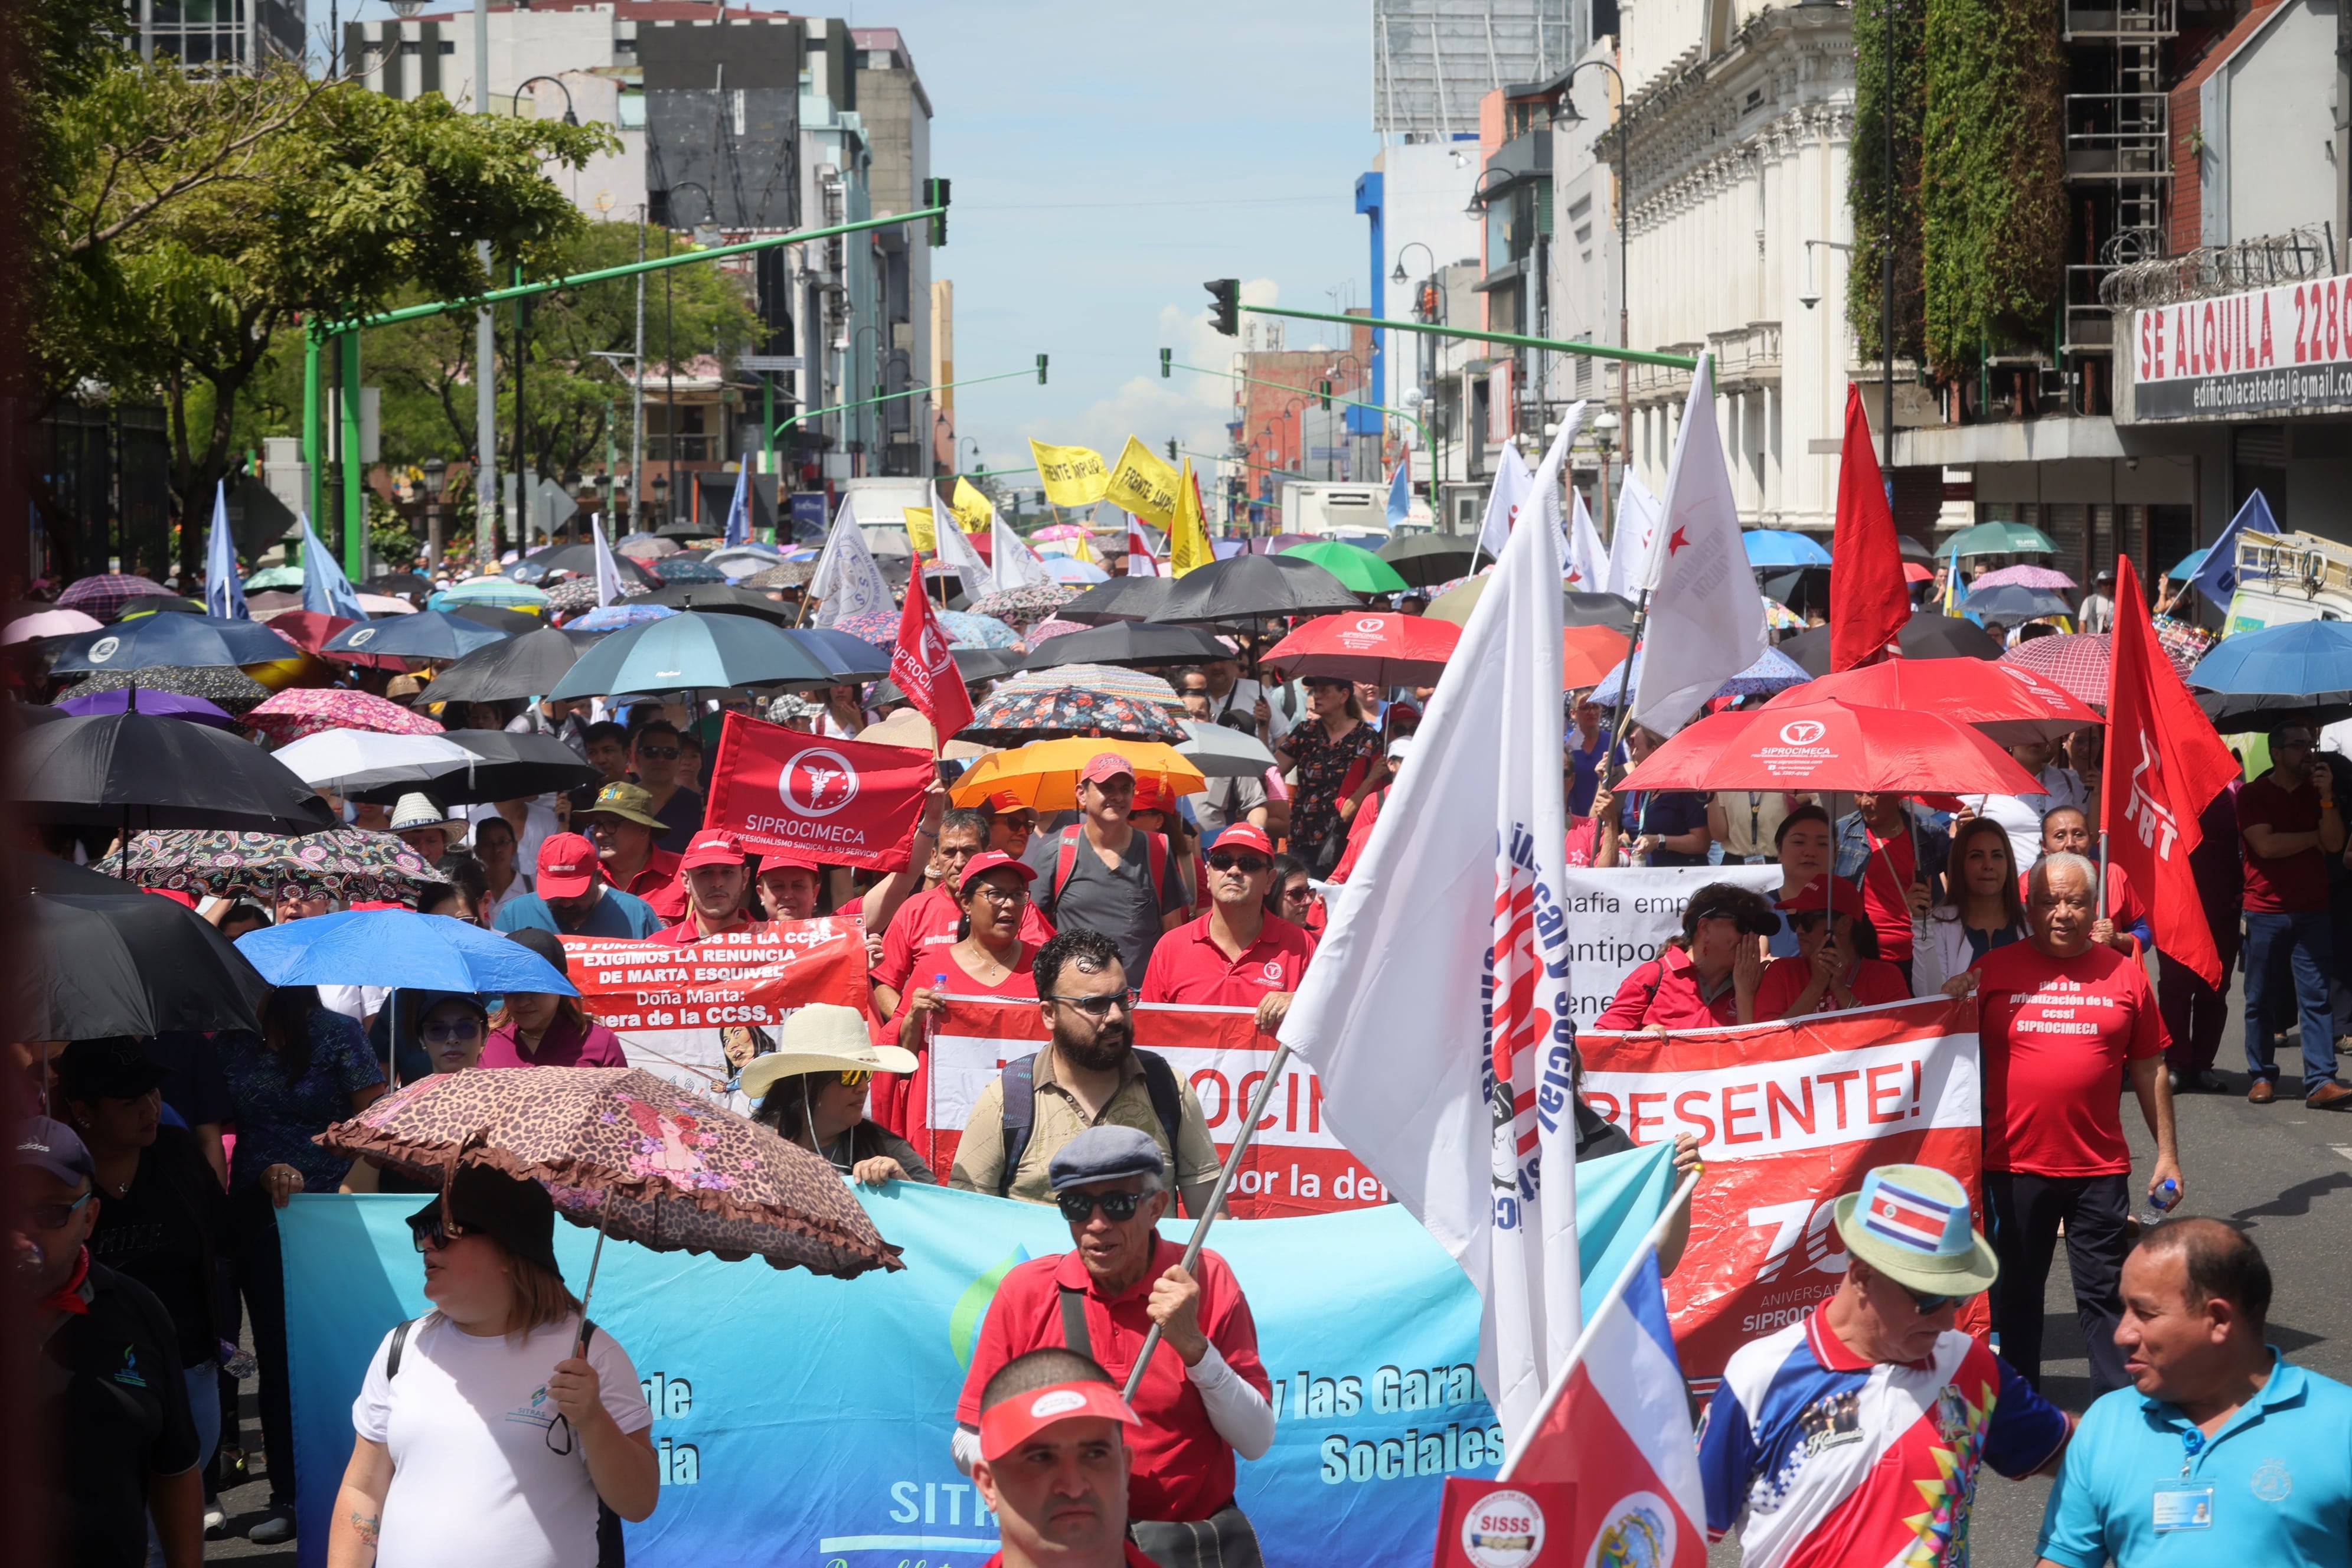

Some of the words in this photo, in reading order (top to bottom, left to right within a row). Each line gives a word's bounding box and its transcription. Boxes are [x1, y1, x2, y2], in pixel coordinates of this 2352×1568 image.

[2142, 311, 2164, 381] SE
[2175, 292, 2274, 377] ALQUILA
[1122, 466, 1153, 499] FRENTE
[745, 814, 865, 844] SIPROCIMECA
[2124, 784, 2178, 861] PRT
[793, 841, 826, 852] SINDICAL
[845, 847, 878, 858] SERVICIO
[728, 933, 752, 945] DE
[756, 932, 781, 945] LA
[784, 929, 832, 946] CCSS
[583, 951, 669, 968] EXIGIMOS
[674, 950, 698, 963] LA
[703, 948, 796, 962] RENUNCIA
[599, 970, 623, 985] DE
[627, 968, 689, 984] MARTA
[694, 965, 784, 982] ESQUIVEL
[2039, 981, 2058, 991] ¡No
[2060, 982, 2067, 991] a
[2069, 981, 2080, 991] la
[636, 988, 681, 1006] Doña
[686, 988, 745, 1005] Marta:
[2010, 992, 2084, 1005] privatización
[2086, 995, 2101, 1006] de
[2102, 996, 2114, 1007] la
[646, 1008, 675, 1026] de
[680, 1007, 700, 1025] la
[705, 1005, 773, 1025] CCSS,
[2041, 1008, 2075, 1019] ccss!
[2016, 1020, 2098, 1034] SIPROCIMECA
[15, 1142, 50, 1152] adidas
[1289, 1164, 1321, 1198] la
[1294, 1370, 1363, 1420] las
[518, 1407, 546, 1417] SITRAS
[1321, 1423, 1506, 1484] Sociales
[1481, 1515, 1530, 1533] SISSS
